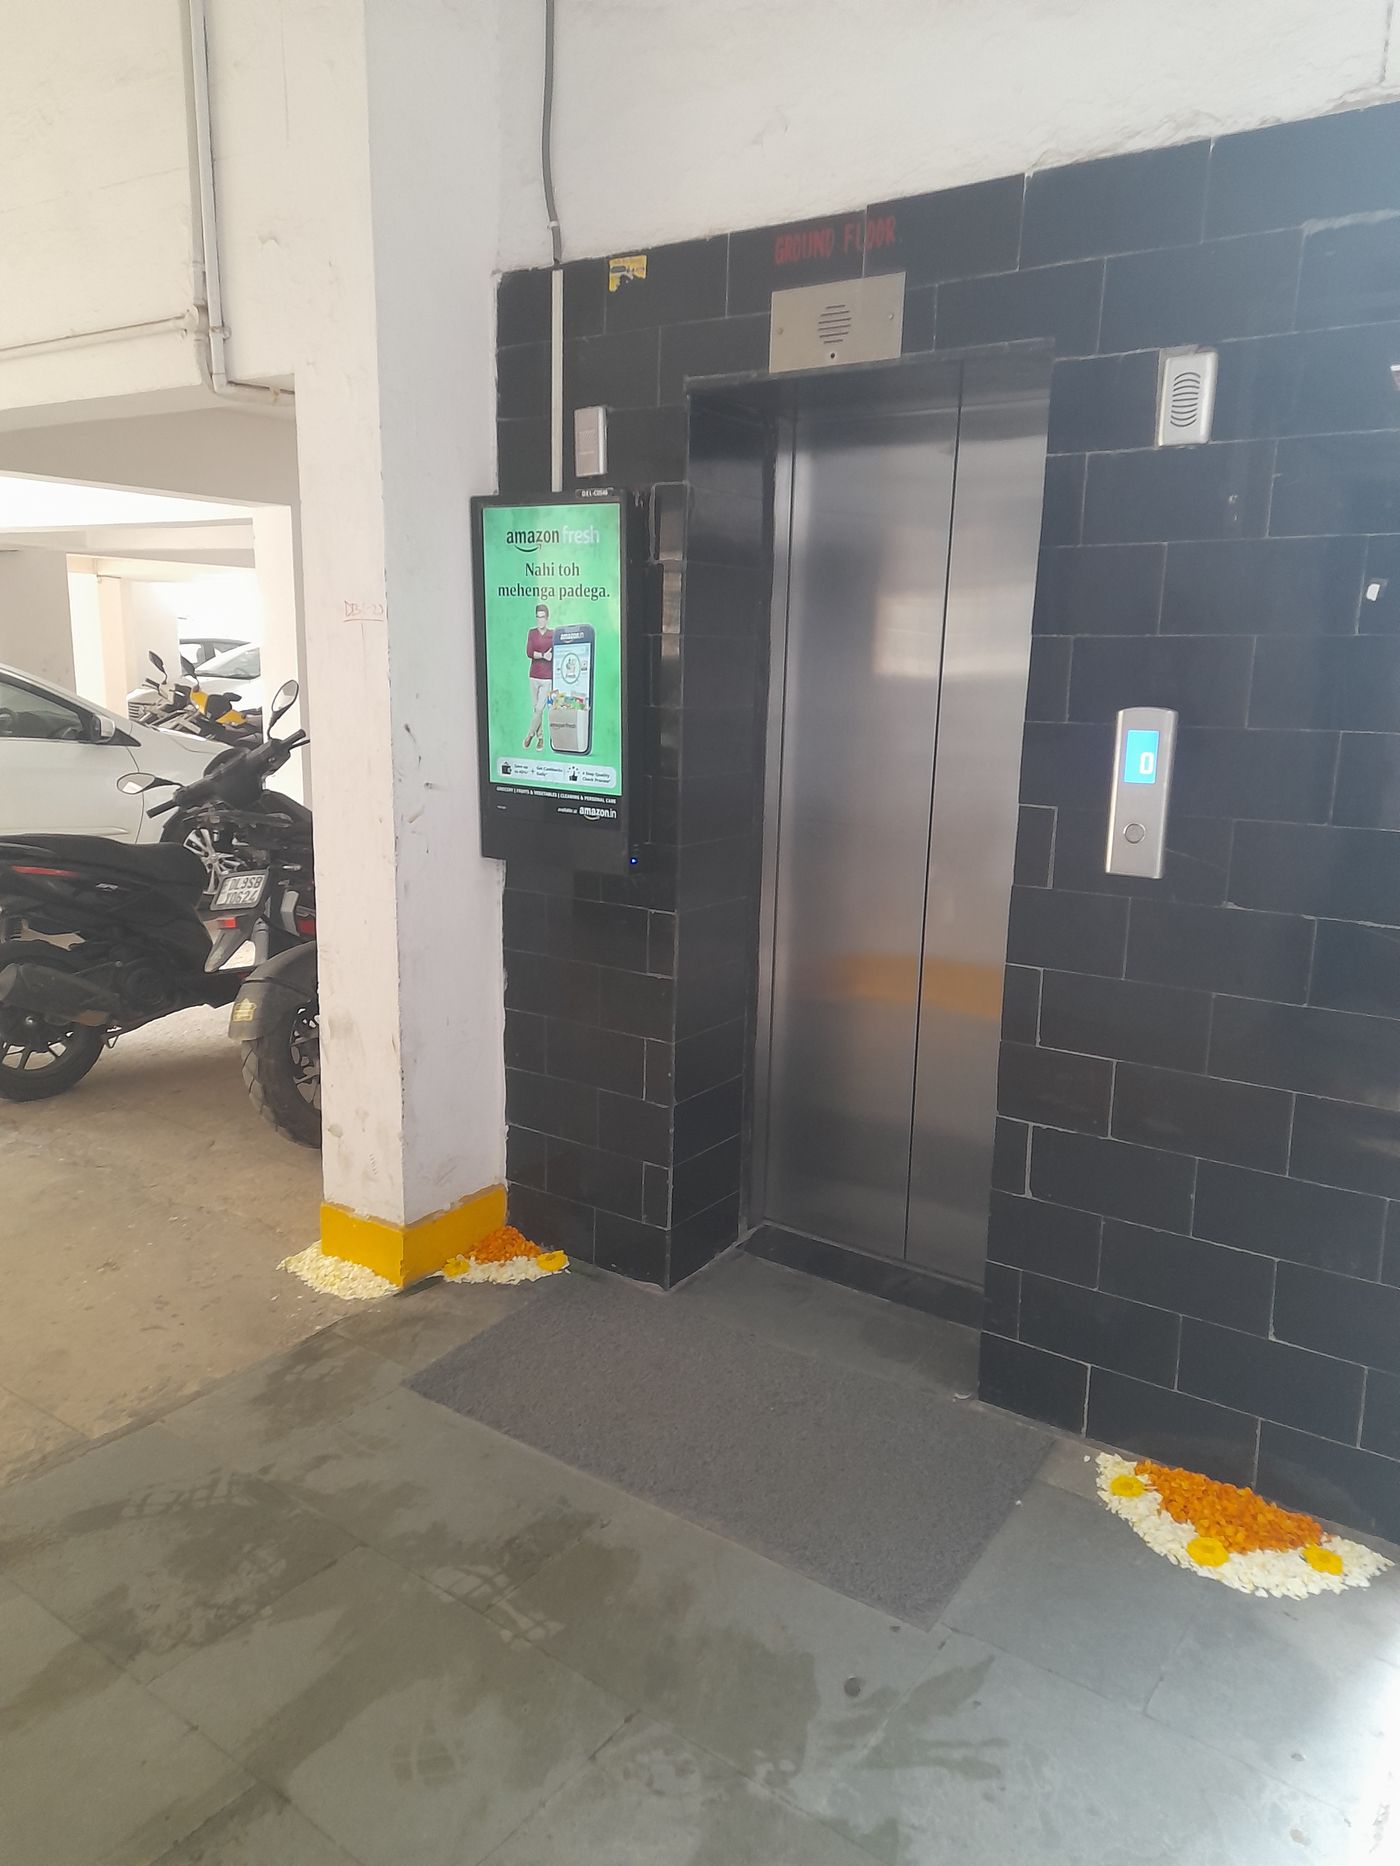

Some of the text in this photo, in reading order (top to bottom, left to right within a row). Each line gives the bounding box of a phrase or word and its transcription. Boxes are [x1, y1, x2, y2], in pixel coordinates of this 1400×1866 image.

[774, 218, 897, 266] GROUND FLOOR
[525, 562, 580, 577] Nahi toh
[498, 583, 611, 601] mehenga padega.
[579, 806, 617, 819] amazon.in
